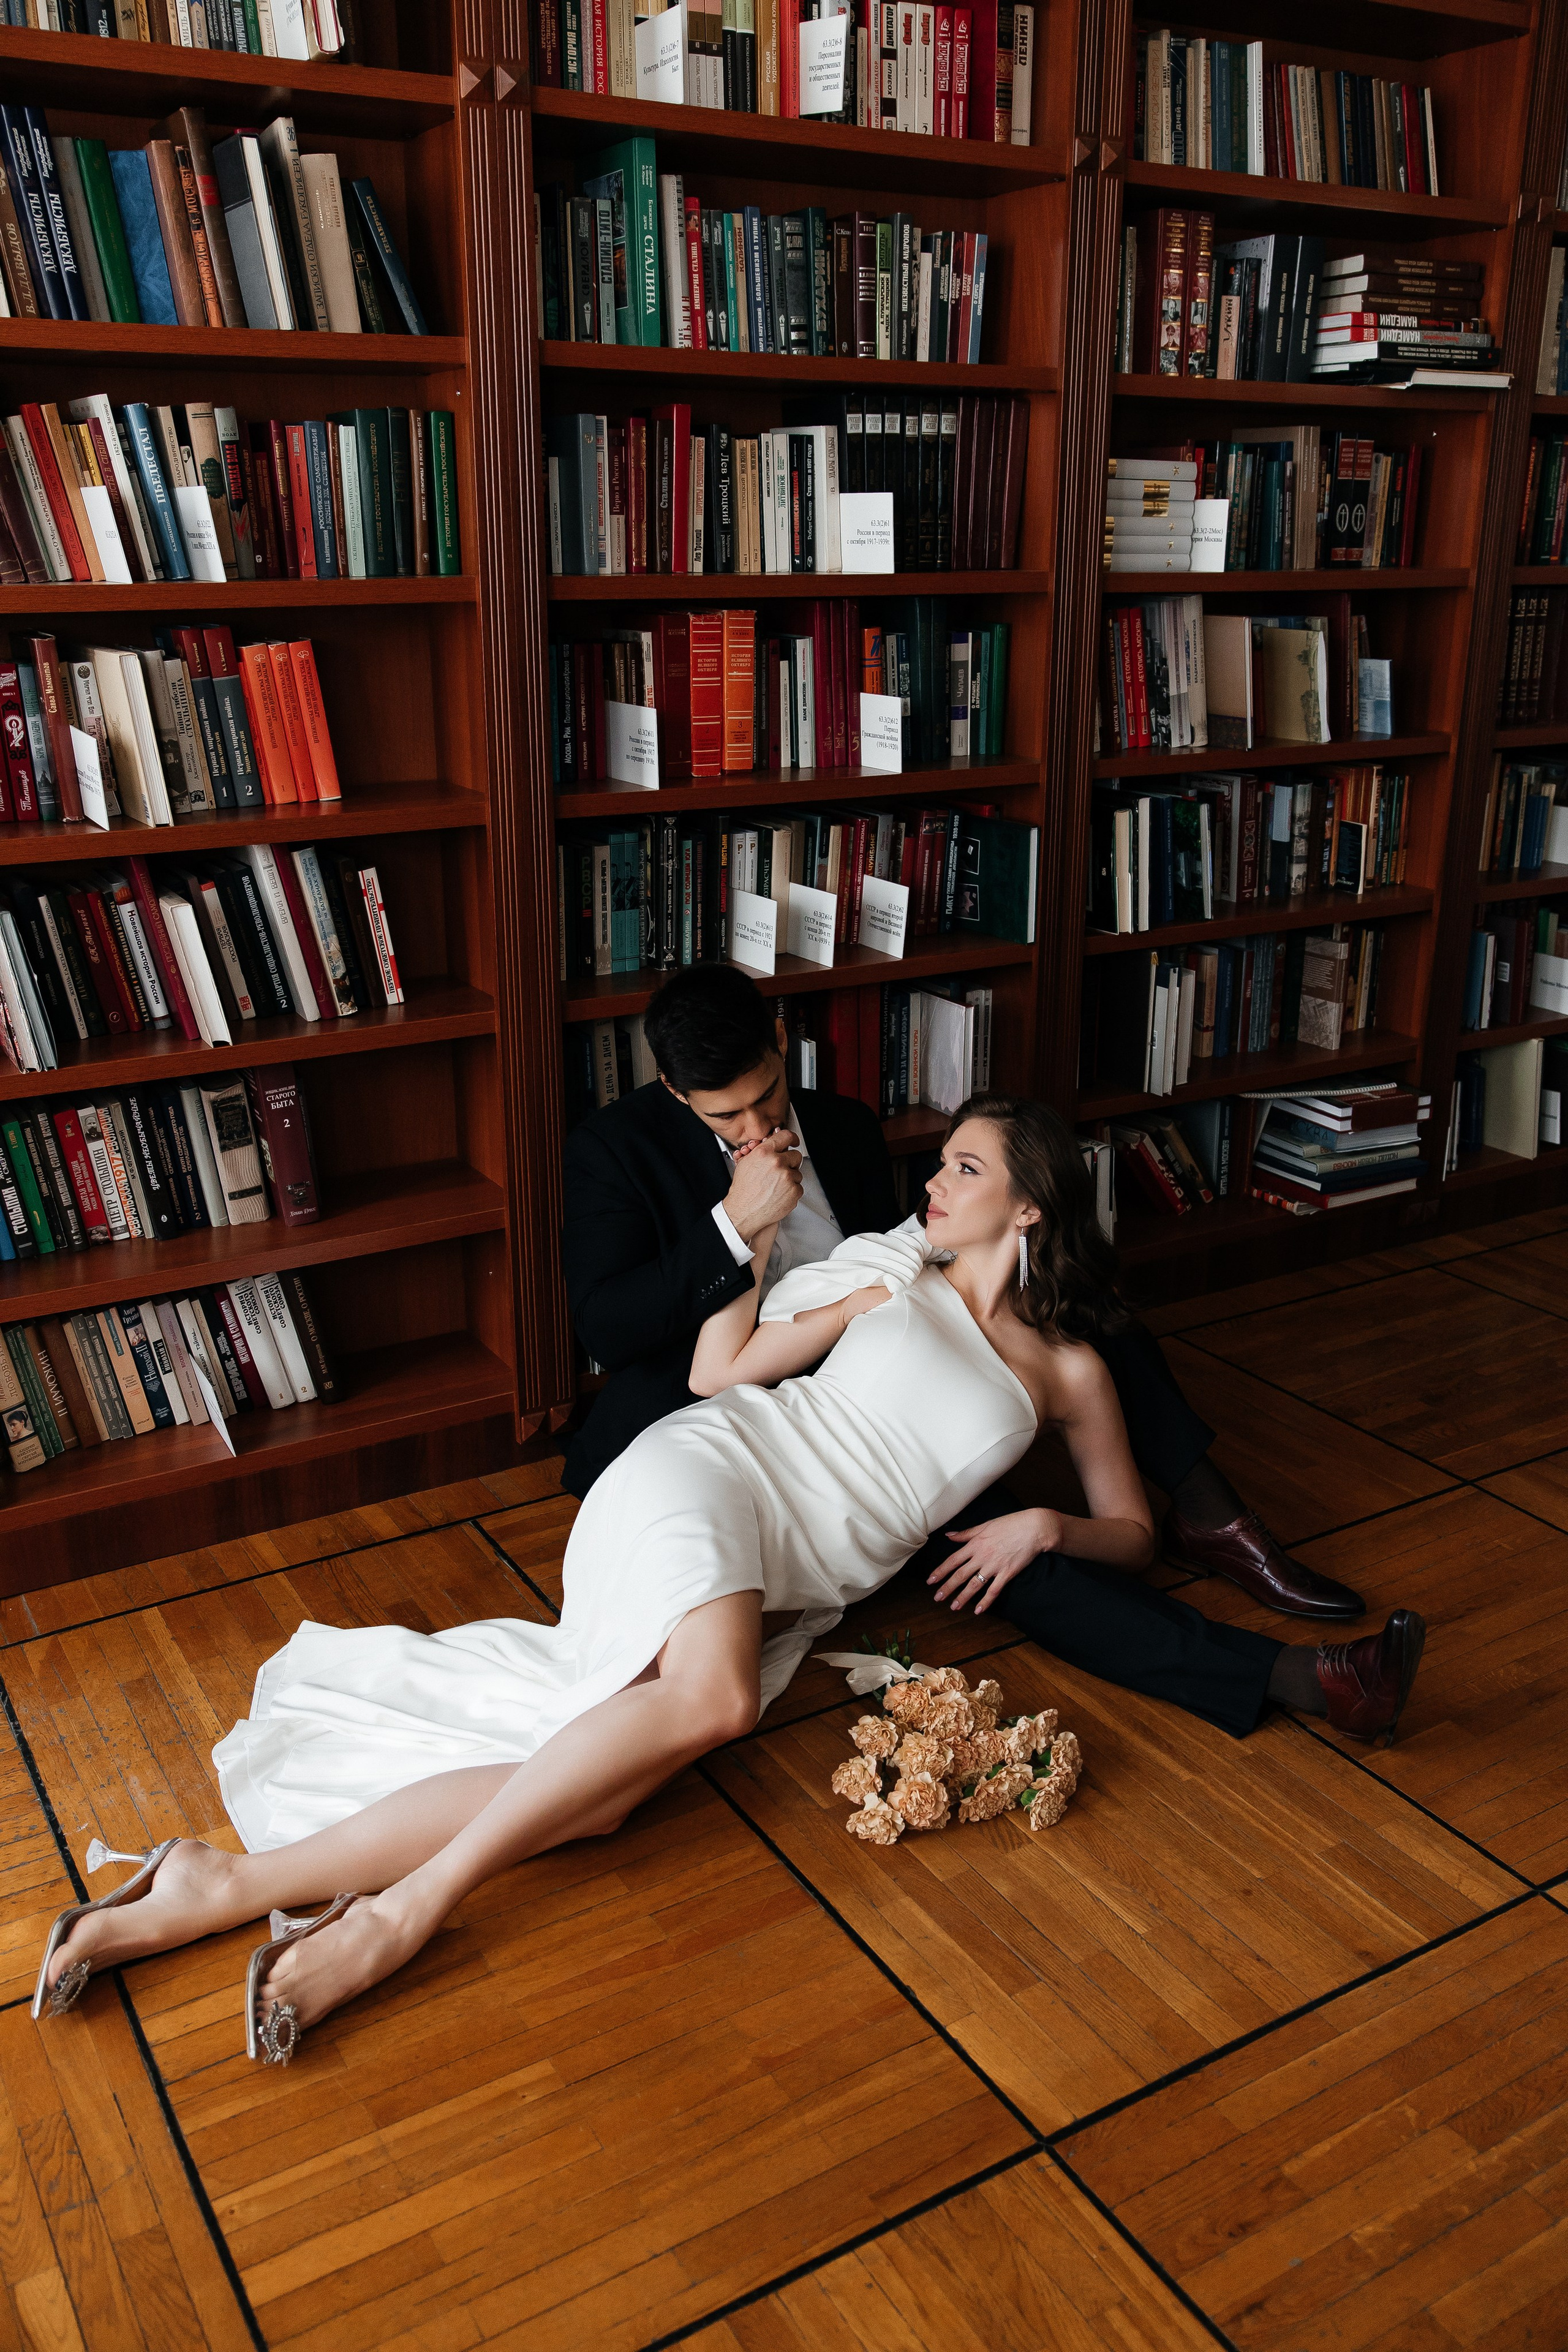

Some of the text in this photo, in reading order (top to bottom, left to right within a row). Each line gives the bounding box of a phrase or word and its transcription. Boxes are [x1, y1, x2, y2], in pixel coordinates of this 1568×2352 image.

[97, 19, 110, 38] 1812
[660, 40, 679, 55] 63.3(2)6-7
[823, 37, 842, 47] 63.3(2)6-8
[567, 31, 577, 73] ИСТОРИЯ
[809, 61, 840, 72] государственных
[818, 50, 842, 59] Персоналии
[937, 40, 950, 91] СЕМЬ ВОЖДЕЙ
[956, 43, 968, 94] СЕМЬ ВОЖДЕЙ
[812, 73, 840, 81] общественных
[12, 127, 29, 177] Биографический
[20, 135, 32, 170] справочник
[34, 128, 50, 178] Биографический
[42, 136, 53, 171] справочник
[287, 126, 295, 141] 36
[28, 192, 57, 273] ДЕКАБРИСТЫ
[48, 193, 77, 273] ДЕКАБРИСТЫ
[291, 158, 324, 309] ЗАПИСКИ ОТДЕЛА РУКОПИСЕЙ
[365, 195, 393, 254] ДЕКАБРИСТЫ
[599, 210, 612, 284] СТАЛИН-ТИТО
[6, 223, 36, 314] В.Л.ДАВЫДОВ
[644, 235, 655, 314] СТАЛИНА
[815, 249, 827, 331] БУХАРИН
[1380, 314, 1417, 328] НАМЕДНИ
[1380, 329, 1420, 342] НАМЕДНИ
[138, 427, 167, 503] ПЬЕДЕСТАЛ
[225, 444, 243, 499] НАРОДНАЯ ВОЛЯ
[311, 428, 325, 529] РОССИЙСКОЕ САМОДЕРЖАВИЕ
[719, 453, 730, 524] Лев Троцкий
[163, 511, 178, 552] В.А.ЛОПАТНИКОВ
[791, 470, 800, 555] НЕПРИМКНУВШИЙ
[43, 662, 54, 694] Мамонтов
[170, 682, 186, 736] Тайна гибели
[176, 677, 194, 738] СТОЛЫПИНА
[878, 715, 897, 724] 63.3(2)612
[199, 697, 220, 777] Первая мировая война.
[224, 696, 244, 775] Первая мировая война.
[862, 730, 885, 740] Гражданской
[876, 741, 898, 751] (1918-1920)
[19, 770, 32, 811] Татищев
[756, 921, 772, 931] 63.3(2)613
[813, 910, 832, 921] 63.3(2)614
[867, 921, 891, 933] Отечественной
[888, 903, 903, 913] 63.3(2)62
[888, 919, 902, 929] Великой
[241, 875, 285, 996] ПАРТИЯ СОЦИАЛИСТОВ-РЕВОЛЮЦИОНЕРОВ
[365, 878, 395, 993] ПЕРВОЕ СОВЕТСКОЕ ПРАВИТЕЛЬСТВО
[126, 910, 160, 1005] Новейшая история России
[266, 1090, 296, 1101] СТАРОГО
[271, 1101, 294, 1110] БЫТА
[129, 1096, 160, 1190] ЦВЕТЫ НЕОБЫЧАЙНЫЕ
[284, 1118, 290, 1128] 2
[92, 1147, 122, 1223] ПЁТР СТОЛЫПИН
[98, 1107, 142, 1237] ФЕВРАЛЬСКАЯ 1917 РЕВОЛЮЦИЯ
[1, 1185, 28, 1235] СТОЛЫПИН
[221, 1299, 238, 1332] СТАЛИНИЗМ
[239, 1295, 253, 1326] ИСТОРИЯ
[243, 1292, 262, 1334] СОВЕТСКОГО
[249, 1290, 260, 1314] СОЮЗА
[263, 1289, 277, 1320] ИСТОРИЯ
[269, 1287, 287, 1329] СОВЕТСКОГО
[274, 1285, 285, 1309] СОЮЗА
[138, 1350, 158, 1382] Николай
[235, 1337, 250, 1364] ИСТОРИЯ
[37, 1349, 65, 1406] НИКОЛАЙ
[224, 1357, 247, 1401] БЕРИЯ:
